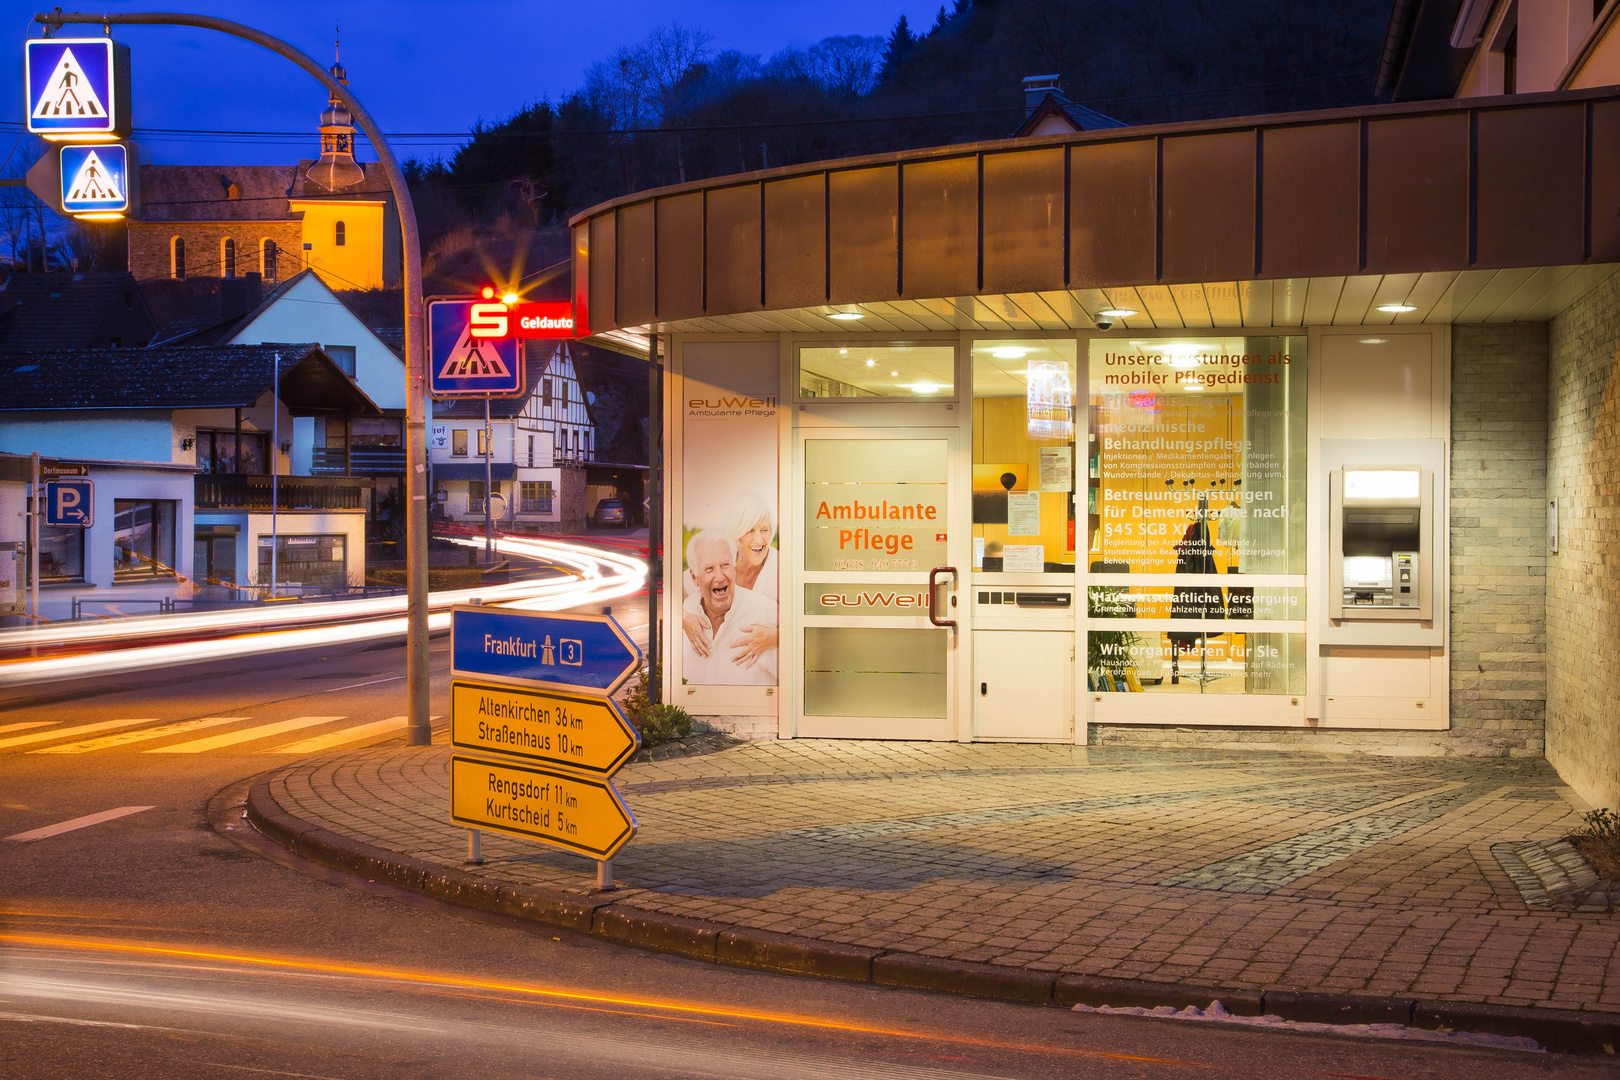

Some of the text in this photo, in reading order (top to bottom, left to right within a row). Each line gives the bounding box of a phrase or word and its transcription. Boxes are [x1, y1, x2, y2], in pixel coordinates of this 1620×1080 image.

[1105, 351, 1292, 368] Unsere Lstungen als
[1105, 370, 1280, 387] mobiler Pflegedienst
[689, 397, 776, 408] euWell
[745, 409, 776, 417] Pflege
[1105, 421, 1205, 433] medizinische
[1105, 438, 1252, 453] Behandlungspflege
[1104, 453, 1147, 461] Injektionen
[1156, 453, 1234, 461] Medikamentengabe
[1244, 453, 1274, 461] nlegen
[1171, 471, 1262, 480] Dekubitus-Behandung
[57, 487, 81, 519] P
[1105, 489, 1273, 503] Betreuungsleistungen
[816, 500, 937, 520] Ambulante
[1104, 505, 1289, 518] für Demenzkranke nach
[1105, 523, 1187, 537] §45 SGB XI
[839, 529, 913, 554] Pflege
[1104, 539, 1146, 547] Begleitung
[1159, 548, 1222, 557] Beaufsichtigung
[820, 591, 930, 609] euWell
[1095, 592, 1298, 606] Hauswirtschaftliche Versorgung
[1210, 606, 1252, 614] zubereiten
[484, 634, 574, 660] Frankfurt 3
[1100, 643, 1279, 660] Wir organisieren für Sie
[1251, 670, 1272, 678] mehr
[478, 696, 584, 730] Altenkirchen 36 km
[478, 721, 584, 757] Straßenhaus 10 km
[488, 773, 578, 809] Rengsdorf 11 km
[486, 797, 578, 836] Kurtscheid 5 km
